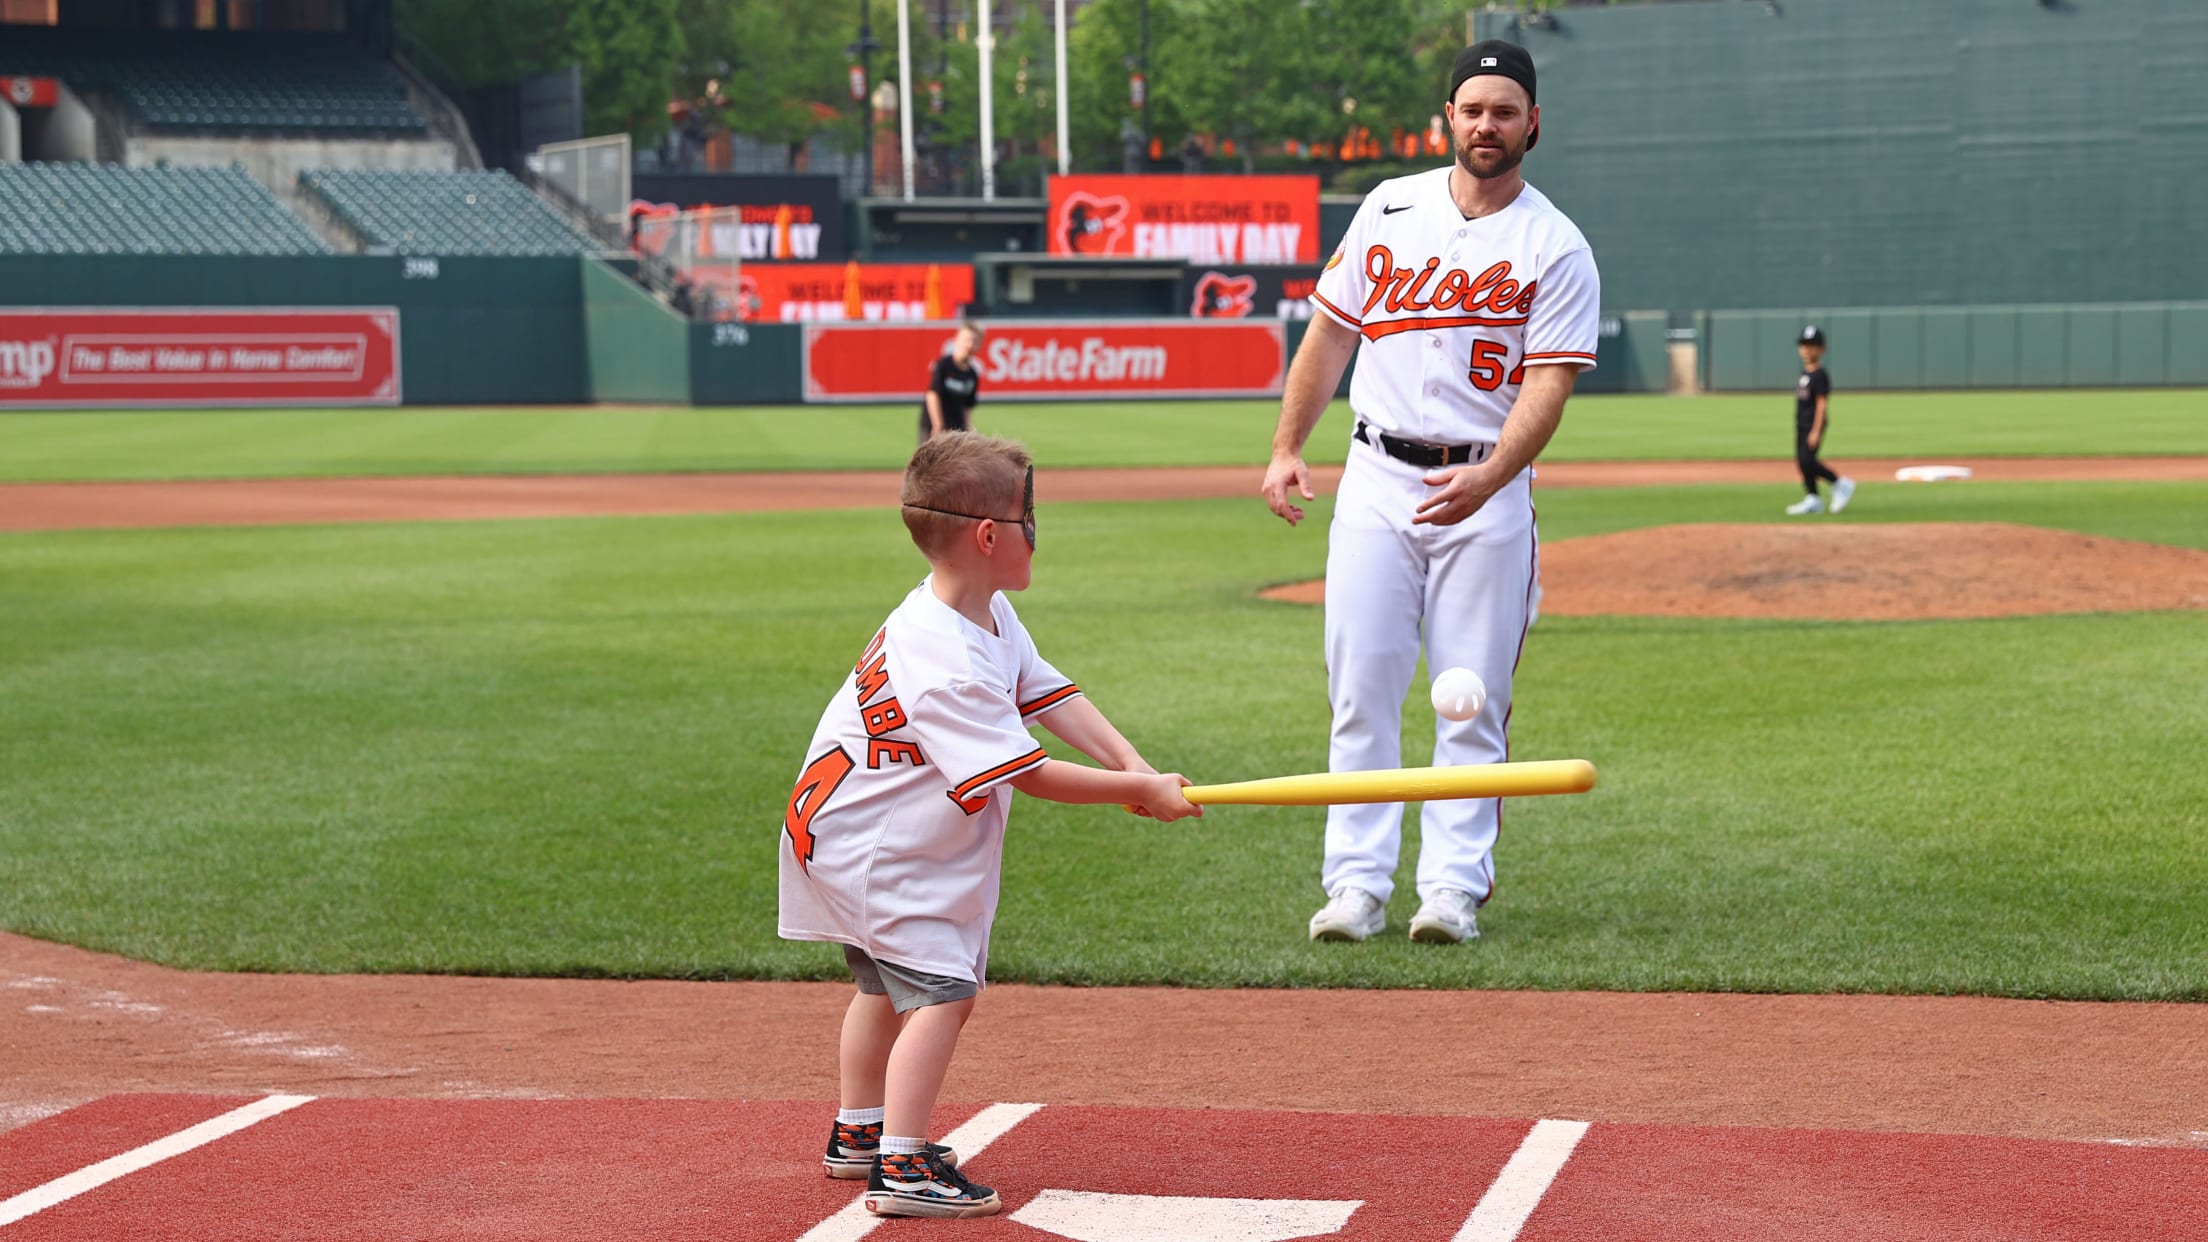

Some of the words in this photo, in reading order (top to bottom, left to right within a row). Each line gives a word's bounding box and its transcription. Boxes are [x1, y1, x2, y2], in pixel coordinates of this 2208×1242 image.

[1141, 203, 1251, 222] WELCOME
[1262, 203, 1291, 222] TO
[1134, 223, 1240, 265] FAMILY
[1242, 223, 1302, 264] DAY
[787, 282, 895, 299] WELCME
[1362, 245, 1537, 316] Orioles
[74, 347, 105, 370] The
[109, 347, 151, 370] Best
[156, 347, 205, 370] Value
